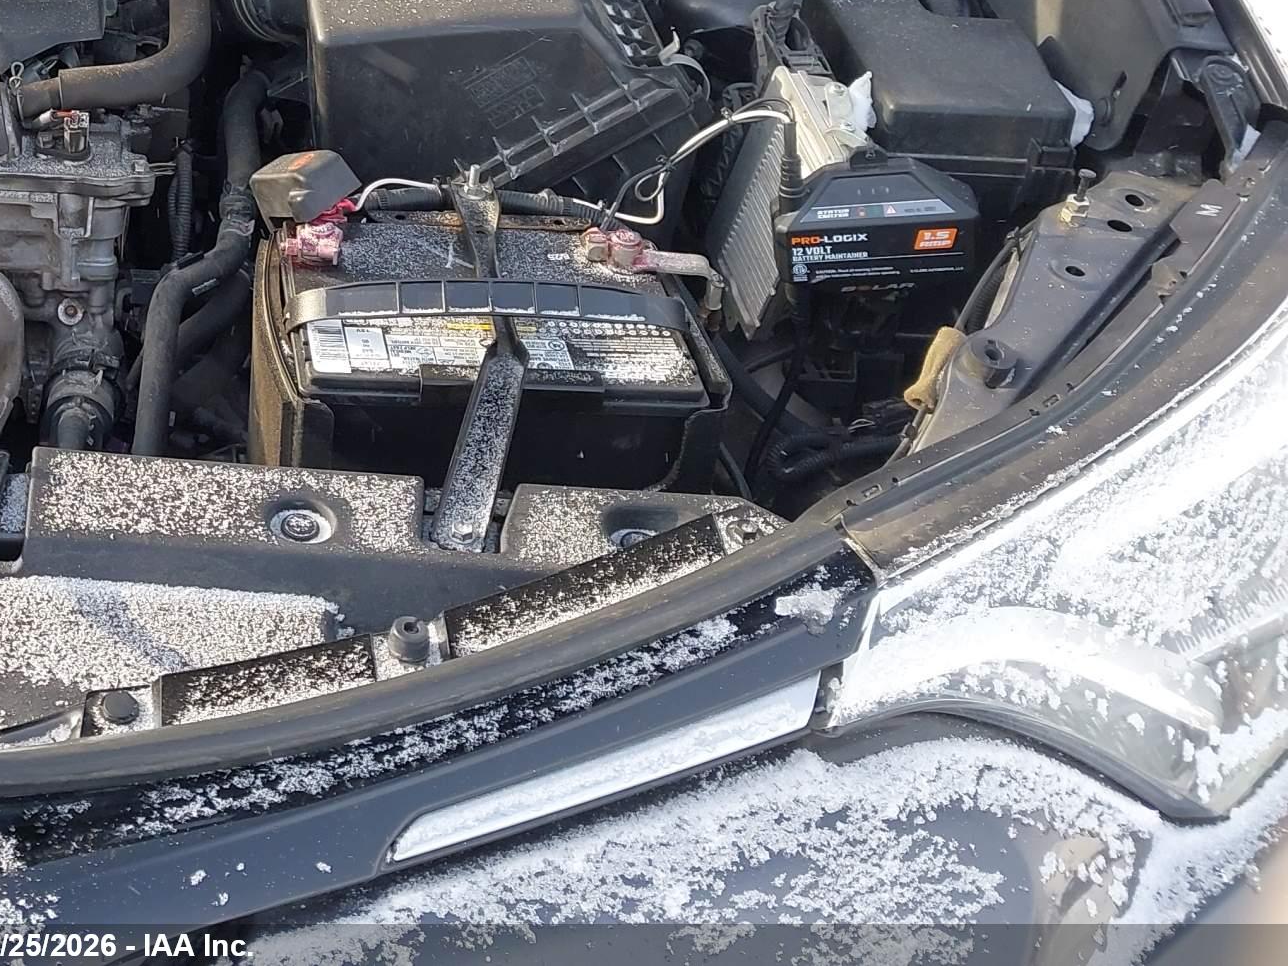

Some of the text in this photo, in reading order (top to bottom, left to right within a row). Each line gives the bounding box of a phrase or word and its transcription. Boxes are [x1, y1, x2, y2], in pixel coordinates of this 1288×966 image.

[791, 233, 869, 245] PRO-LOGIX
[923, 230, 951, 241] 1.5
[792, 245, 833, 257] 12 VOLT
[792, 251, 869, 262] BATTERY MAINTAINER
